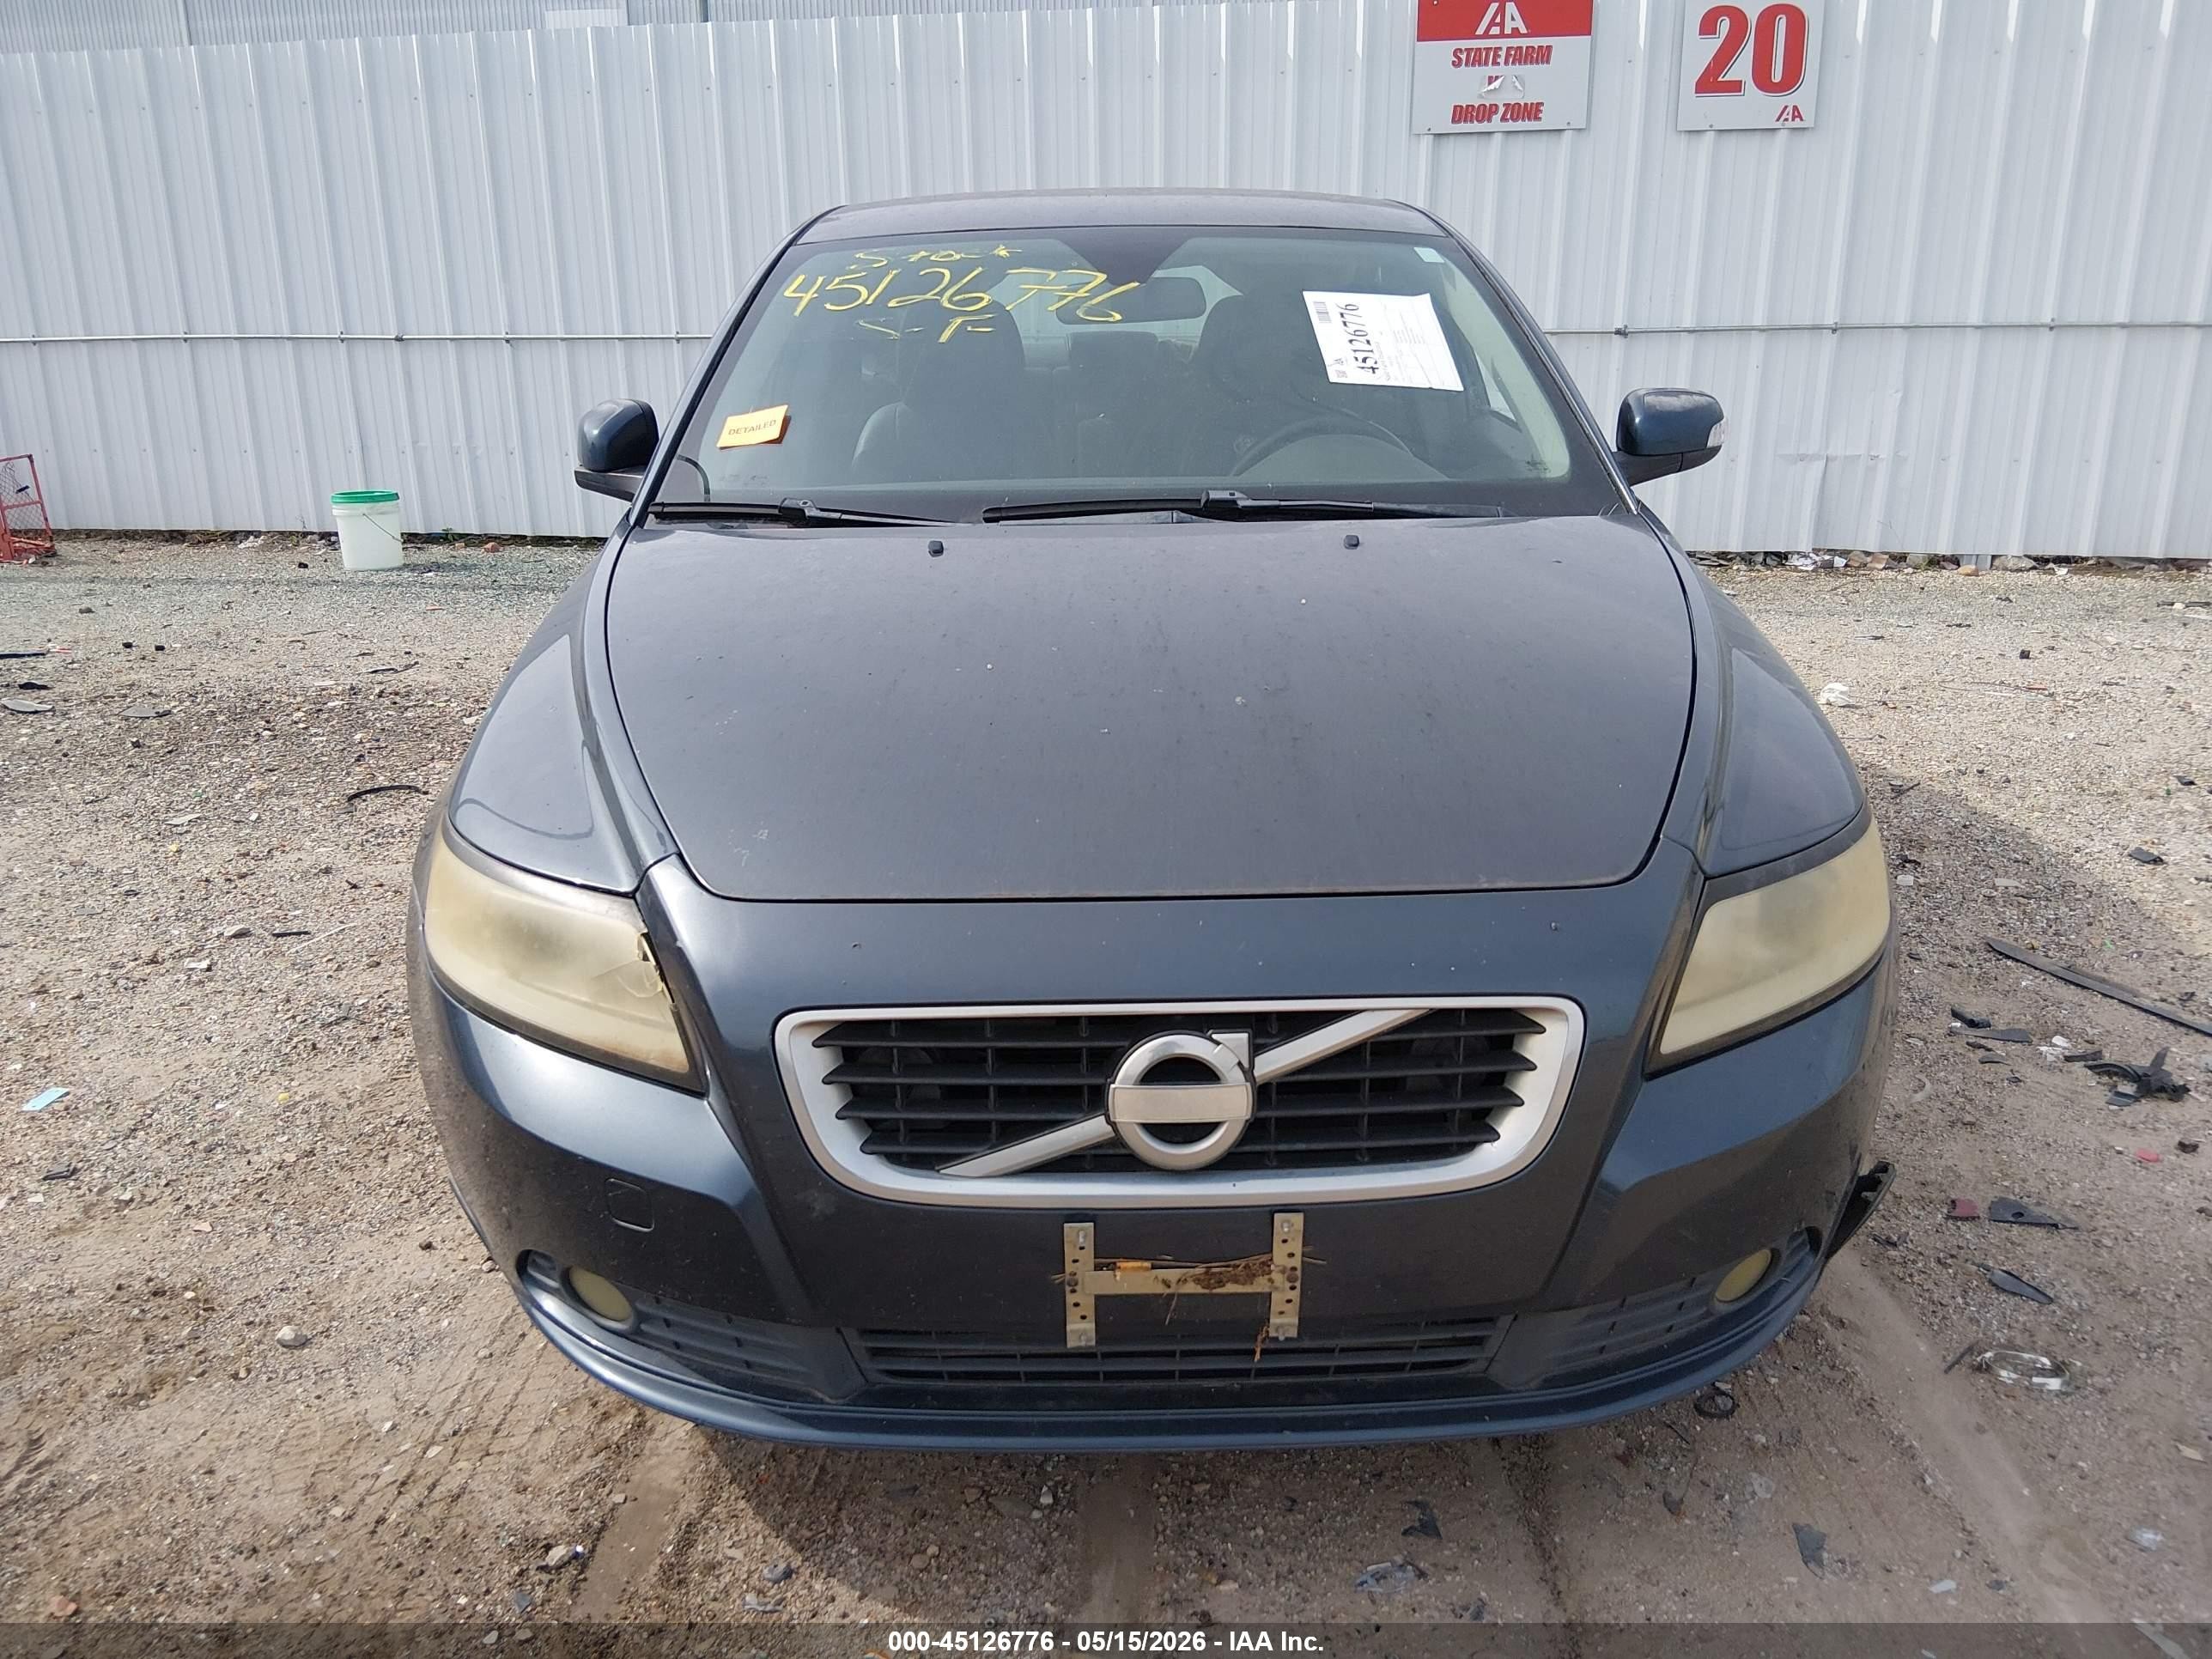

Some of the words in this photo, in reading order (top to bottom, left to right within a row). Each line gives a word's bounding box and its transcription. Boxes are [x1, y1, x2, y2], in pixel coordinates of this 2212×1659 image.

[1451, 46, 1503, 68] STATE
[1504, 45, 1553, 66] FARM
[1695, 3, 1808, 96] 20
[1451, 103, 1499, 125] DROP
[1500, 101, 1544, 122] ZONE
[783, 266, 1142, 322] 45126776
[1335, 303, 1379, 374] 45126776
[727, 420, 776, 435] DETAILED
